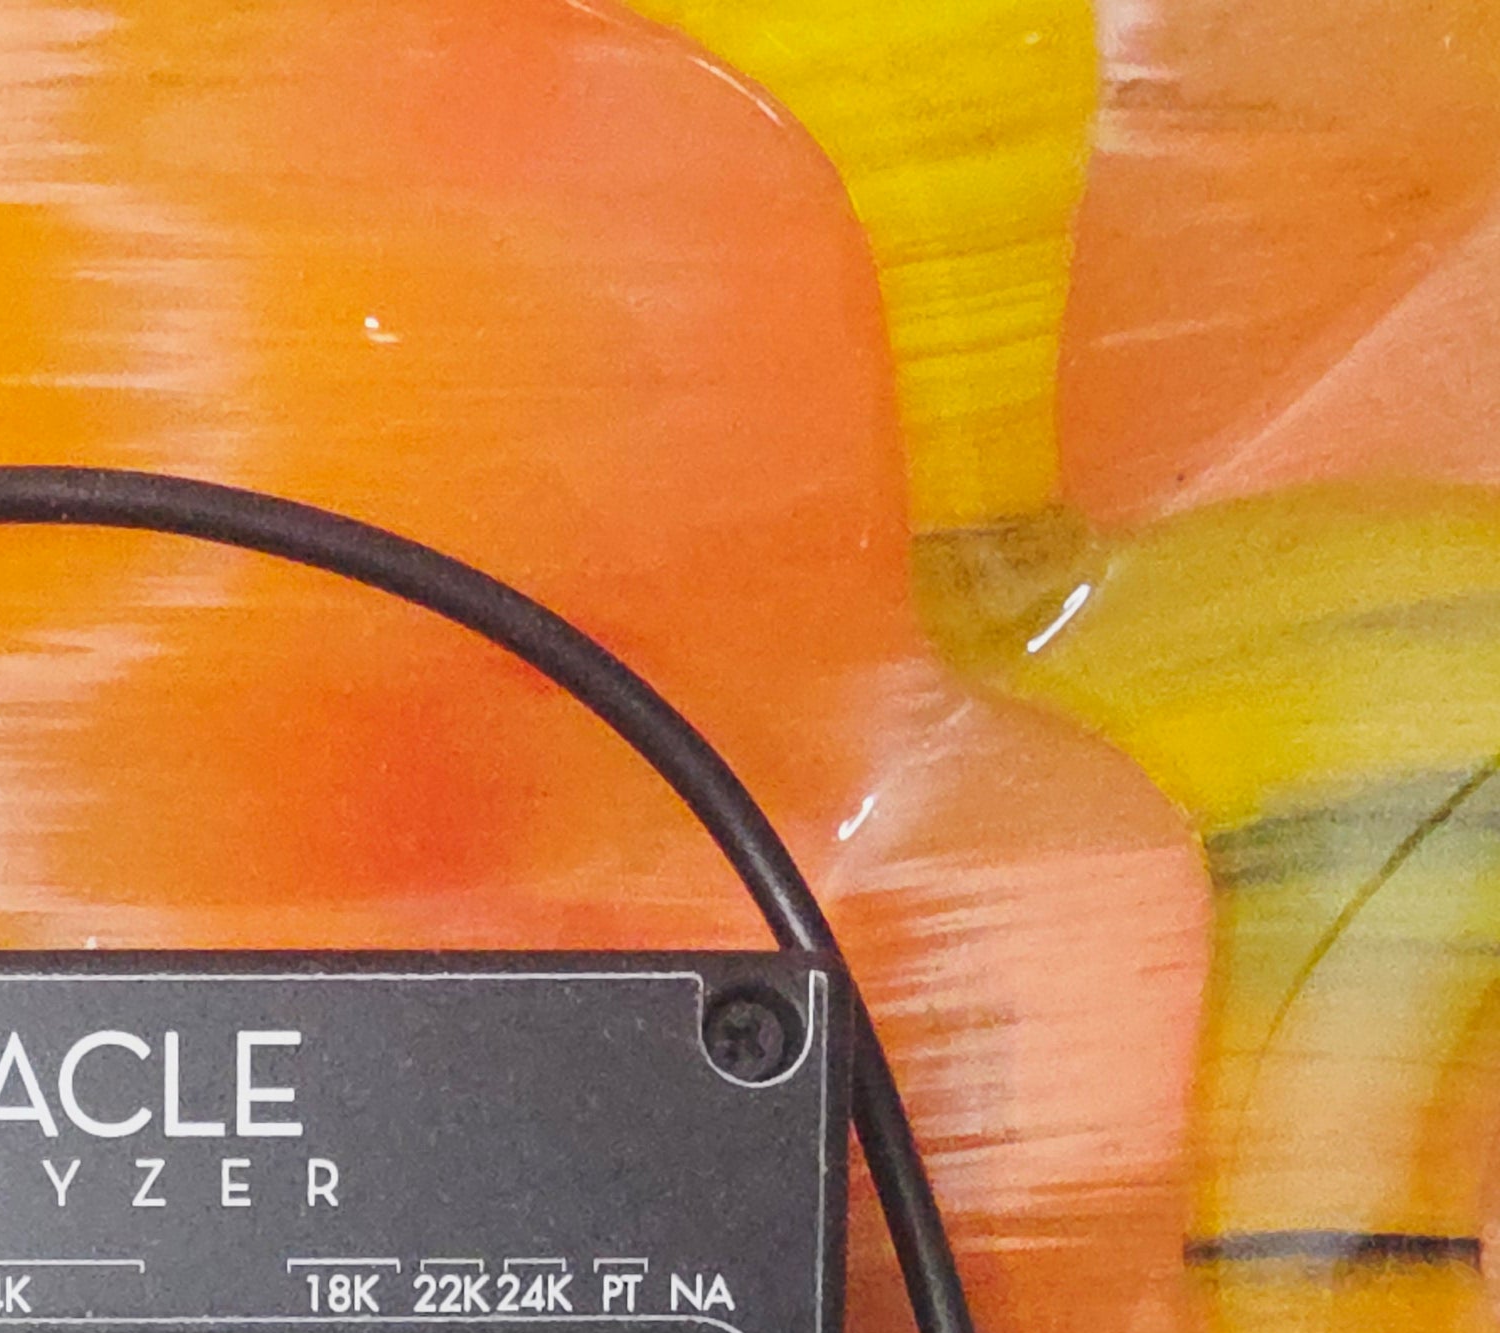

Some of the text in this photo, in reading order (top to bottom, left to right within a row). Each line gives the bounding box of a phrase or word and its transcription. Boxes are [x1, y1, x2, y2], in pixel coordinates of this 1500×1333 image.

[306, 1274, 380, 1313] 18K
[413, 1274, 490, 1313] 22K
[496, 1273, 573, 1312] 24K
[602, 1273, 643, 1312] PT
[669, 1273, 736, 1312] NA
